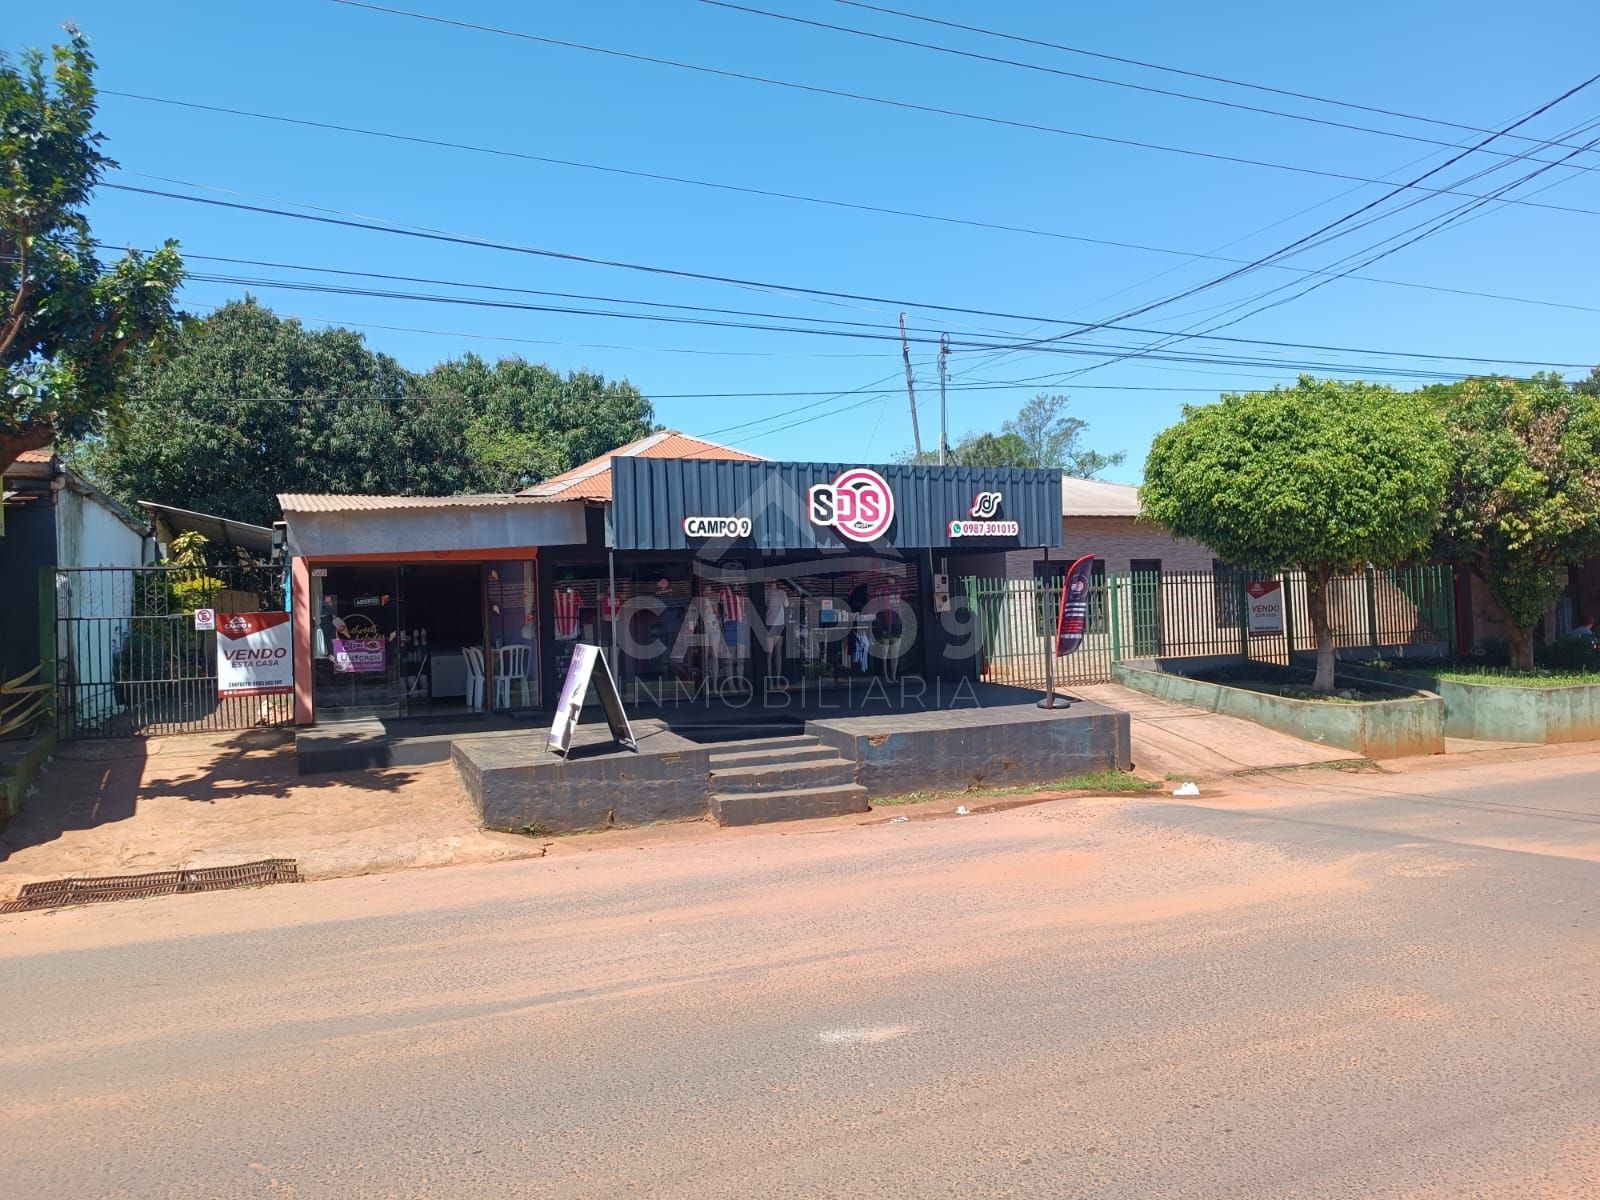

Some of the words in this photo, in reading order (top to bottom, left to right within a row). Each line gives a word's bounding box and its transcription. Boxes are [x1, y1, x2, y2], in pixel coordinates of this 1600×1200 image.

[813, 489, 880, 522] SDS
[687, 520, 738, 534] CAMPO
[741, 520, 749, 534] 9
[963, 524, 984, 533] 0987
[987, 524, 1017, 533] 301015
[1252, 604, 1280, 613] VENDO
[224, 648, 287, 660] VENDO
